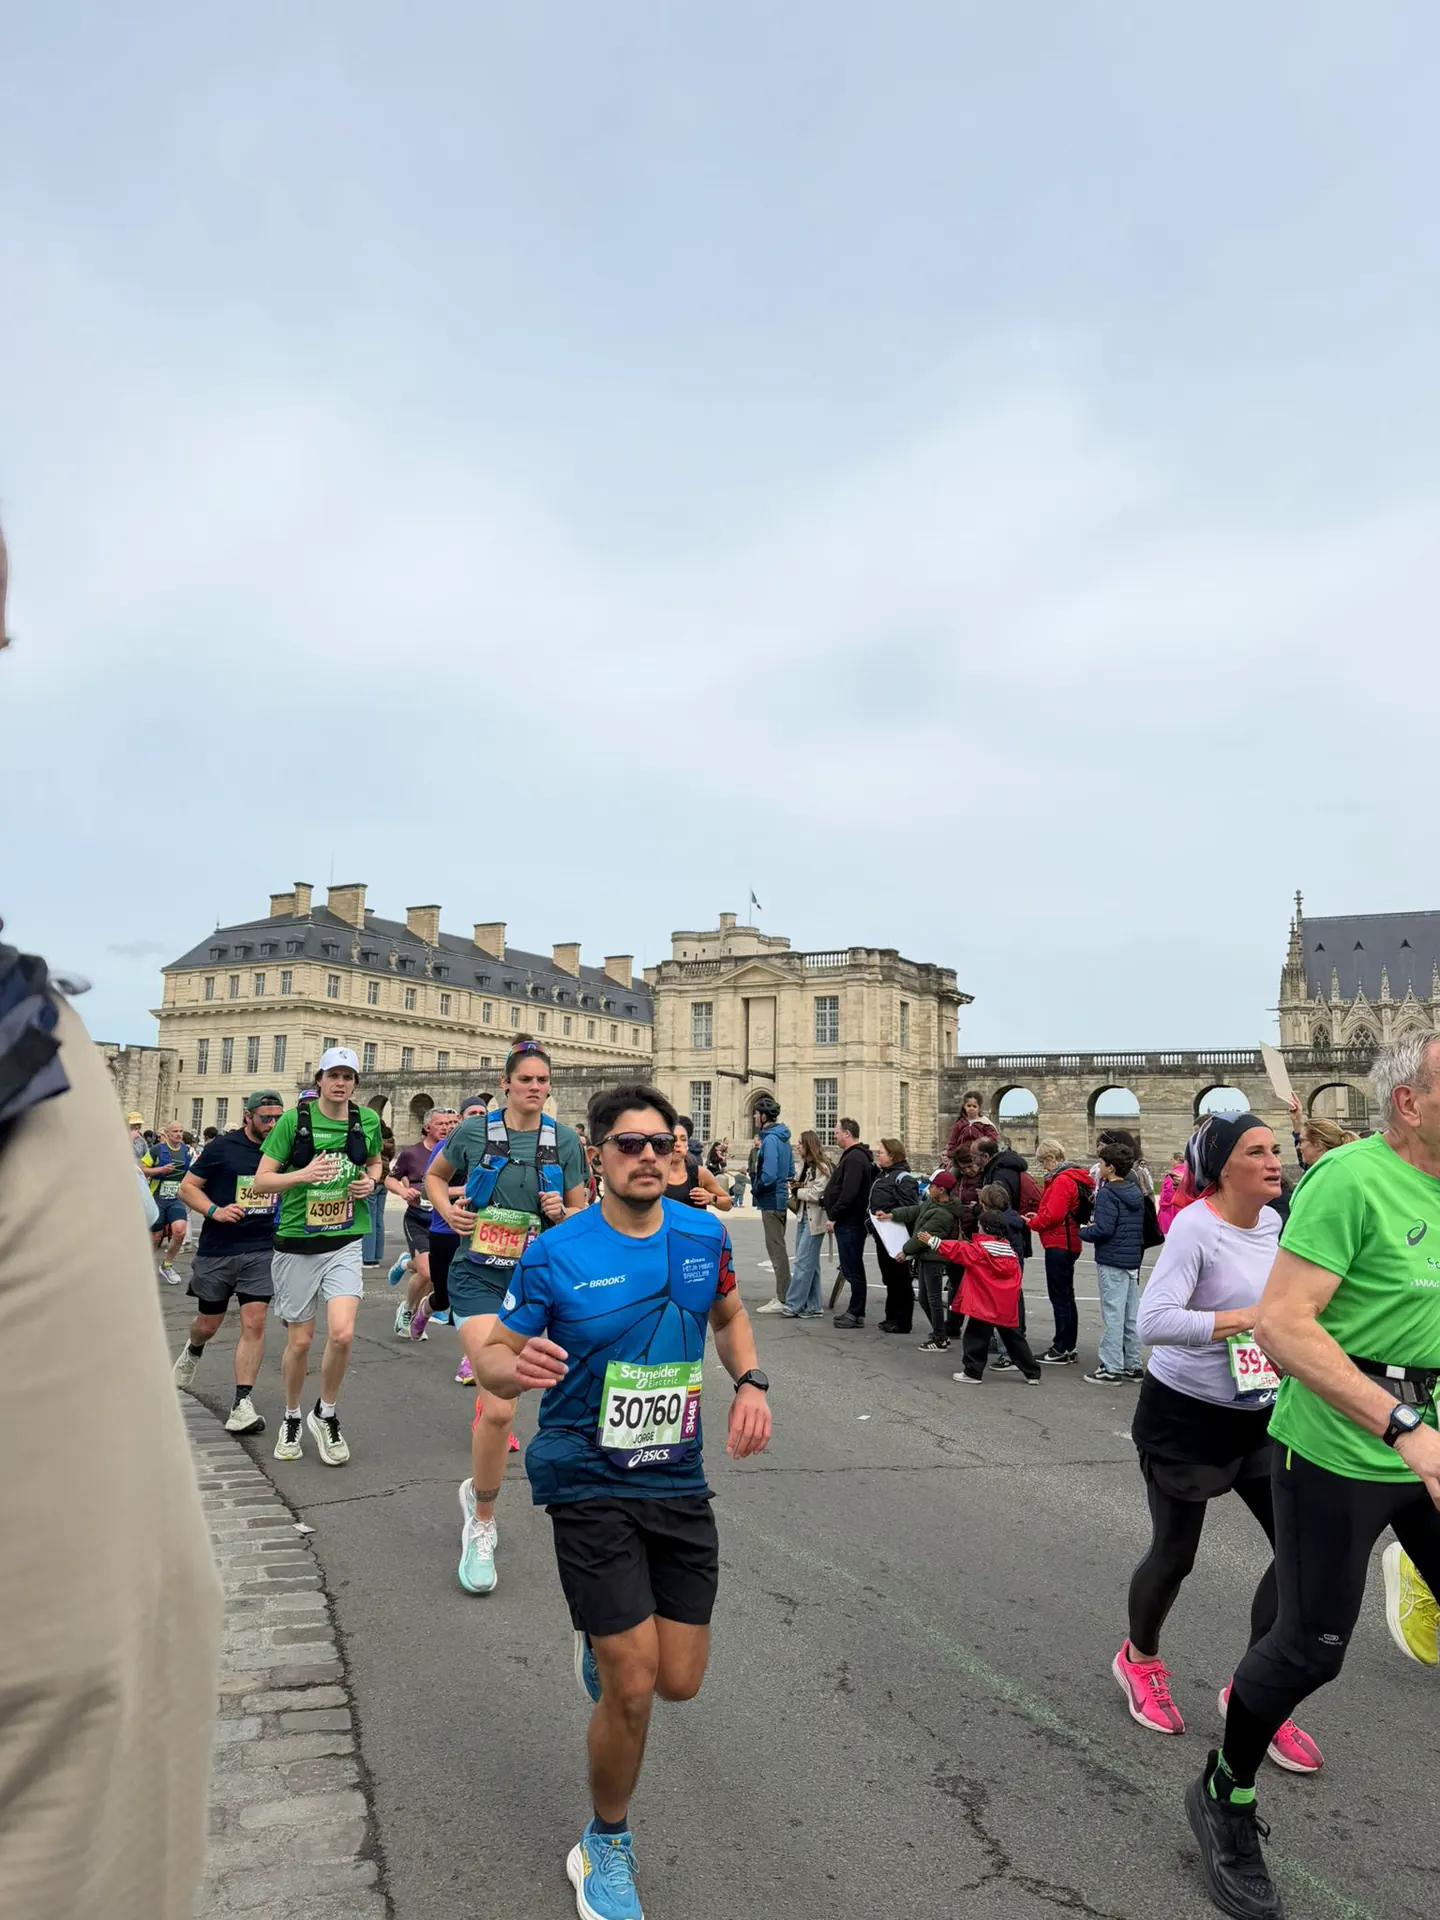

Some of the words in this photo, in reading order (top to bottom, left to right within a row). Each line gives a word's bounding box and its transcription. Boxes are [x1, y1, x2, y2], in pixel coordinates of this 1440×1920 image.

[310, 1201, 345, 1217] 43087
[485, 1205, 524, 1219] Schneider
[495, 1258, 514, 1266] asics
[589, 1274, 626, 1288] BROOKS
[620, 1364, 680, 1380] Schneider
[648, 1378, 678, 1388] Electric
[609, 1393, 681, 1429] 30760
[633, 1431, 655, 1444] JORGE
[643, 1448, 670, 1462] asics
